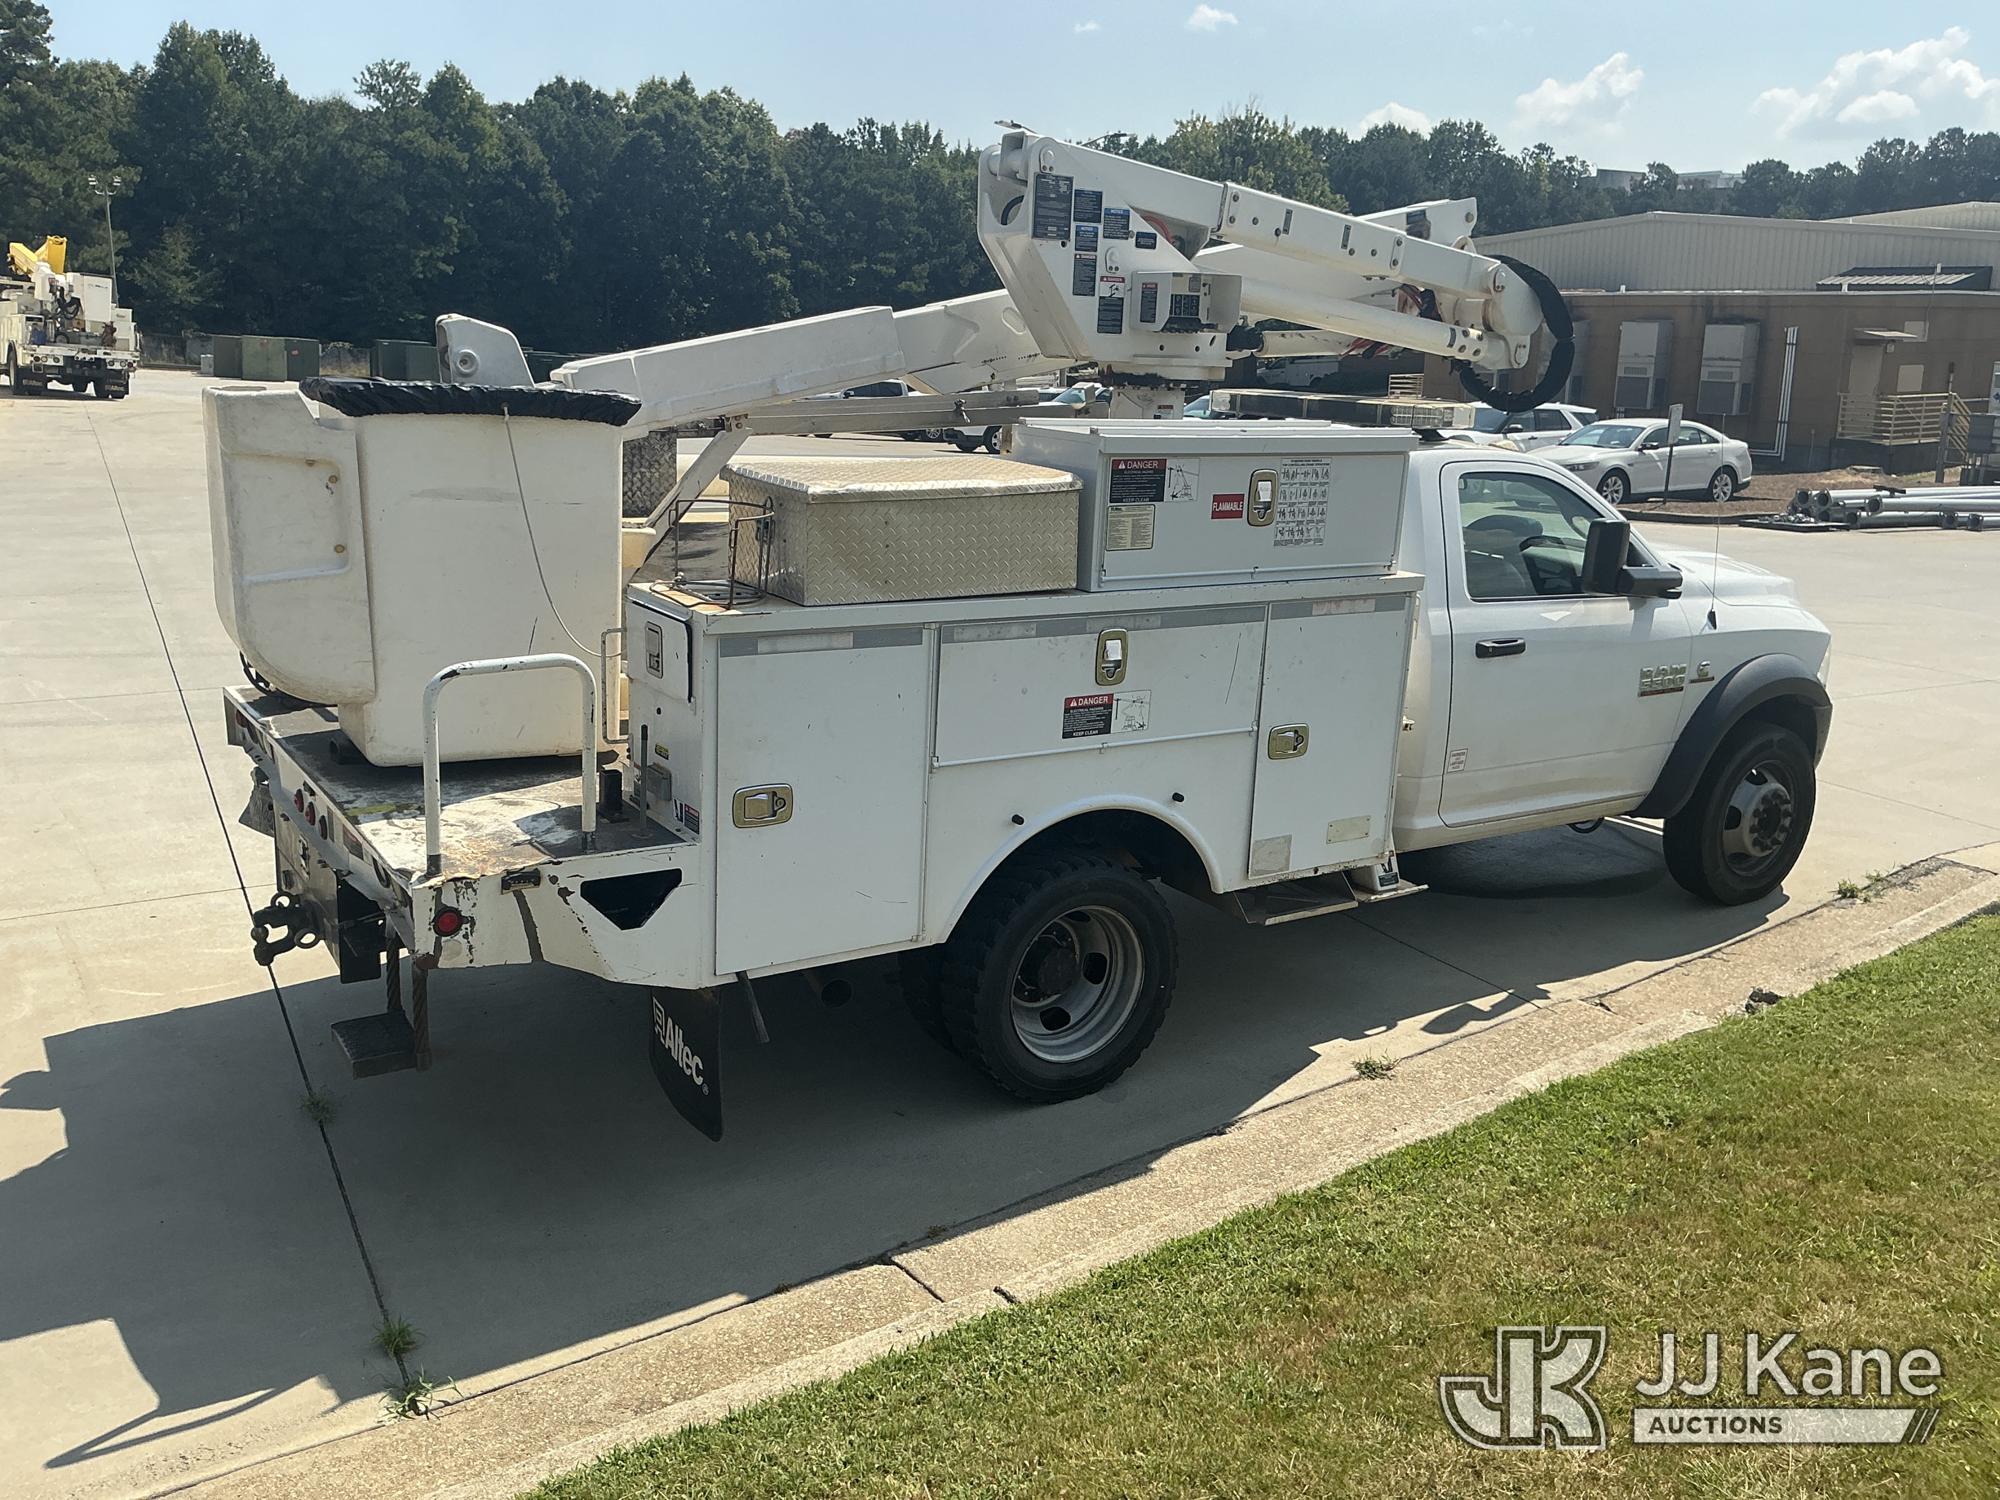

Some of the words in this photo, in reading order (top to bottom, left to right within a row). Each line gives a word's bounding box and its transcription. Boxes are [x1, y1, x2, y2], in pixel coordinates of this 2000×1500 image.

[1127, 460, 1159, 469] DANGER
[1212, 501, 1244, 512] FLAMMABLE
[1640, 663, 1687, 679] RAM
[1078, 696, 1109, 706] DANGER
[664, 1016, 704, 1086] Altec
